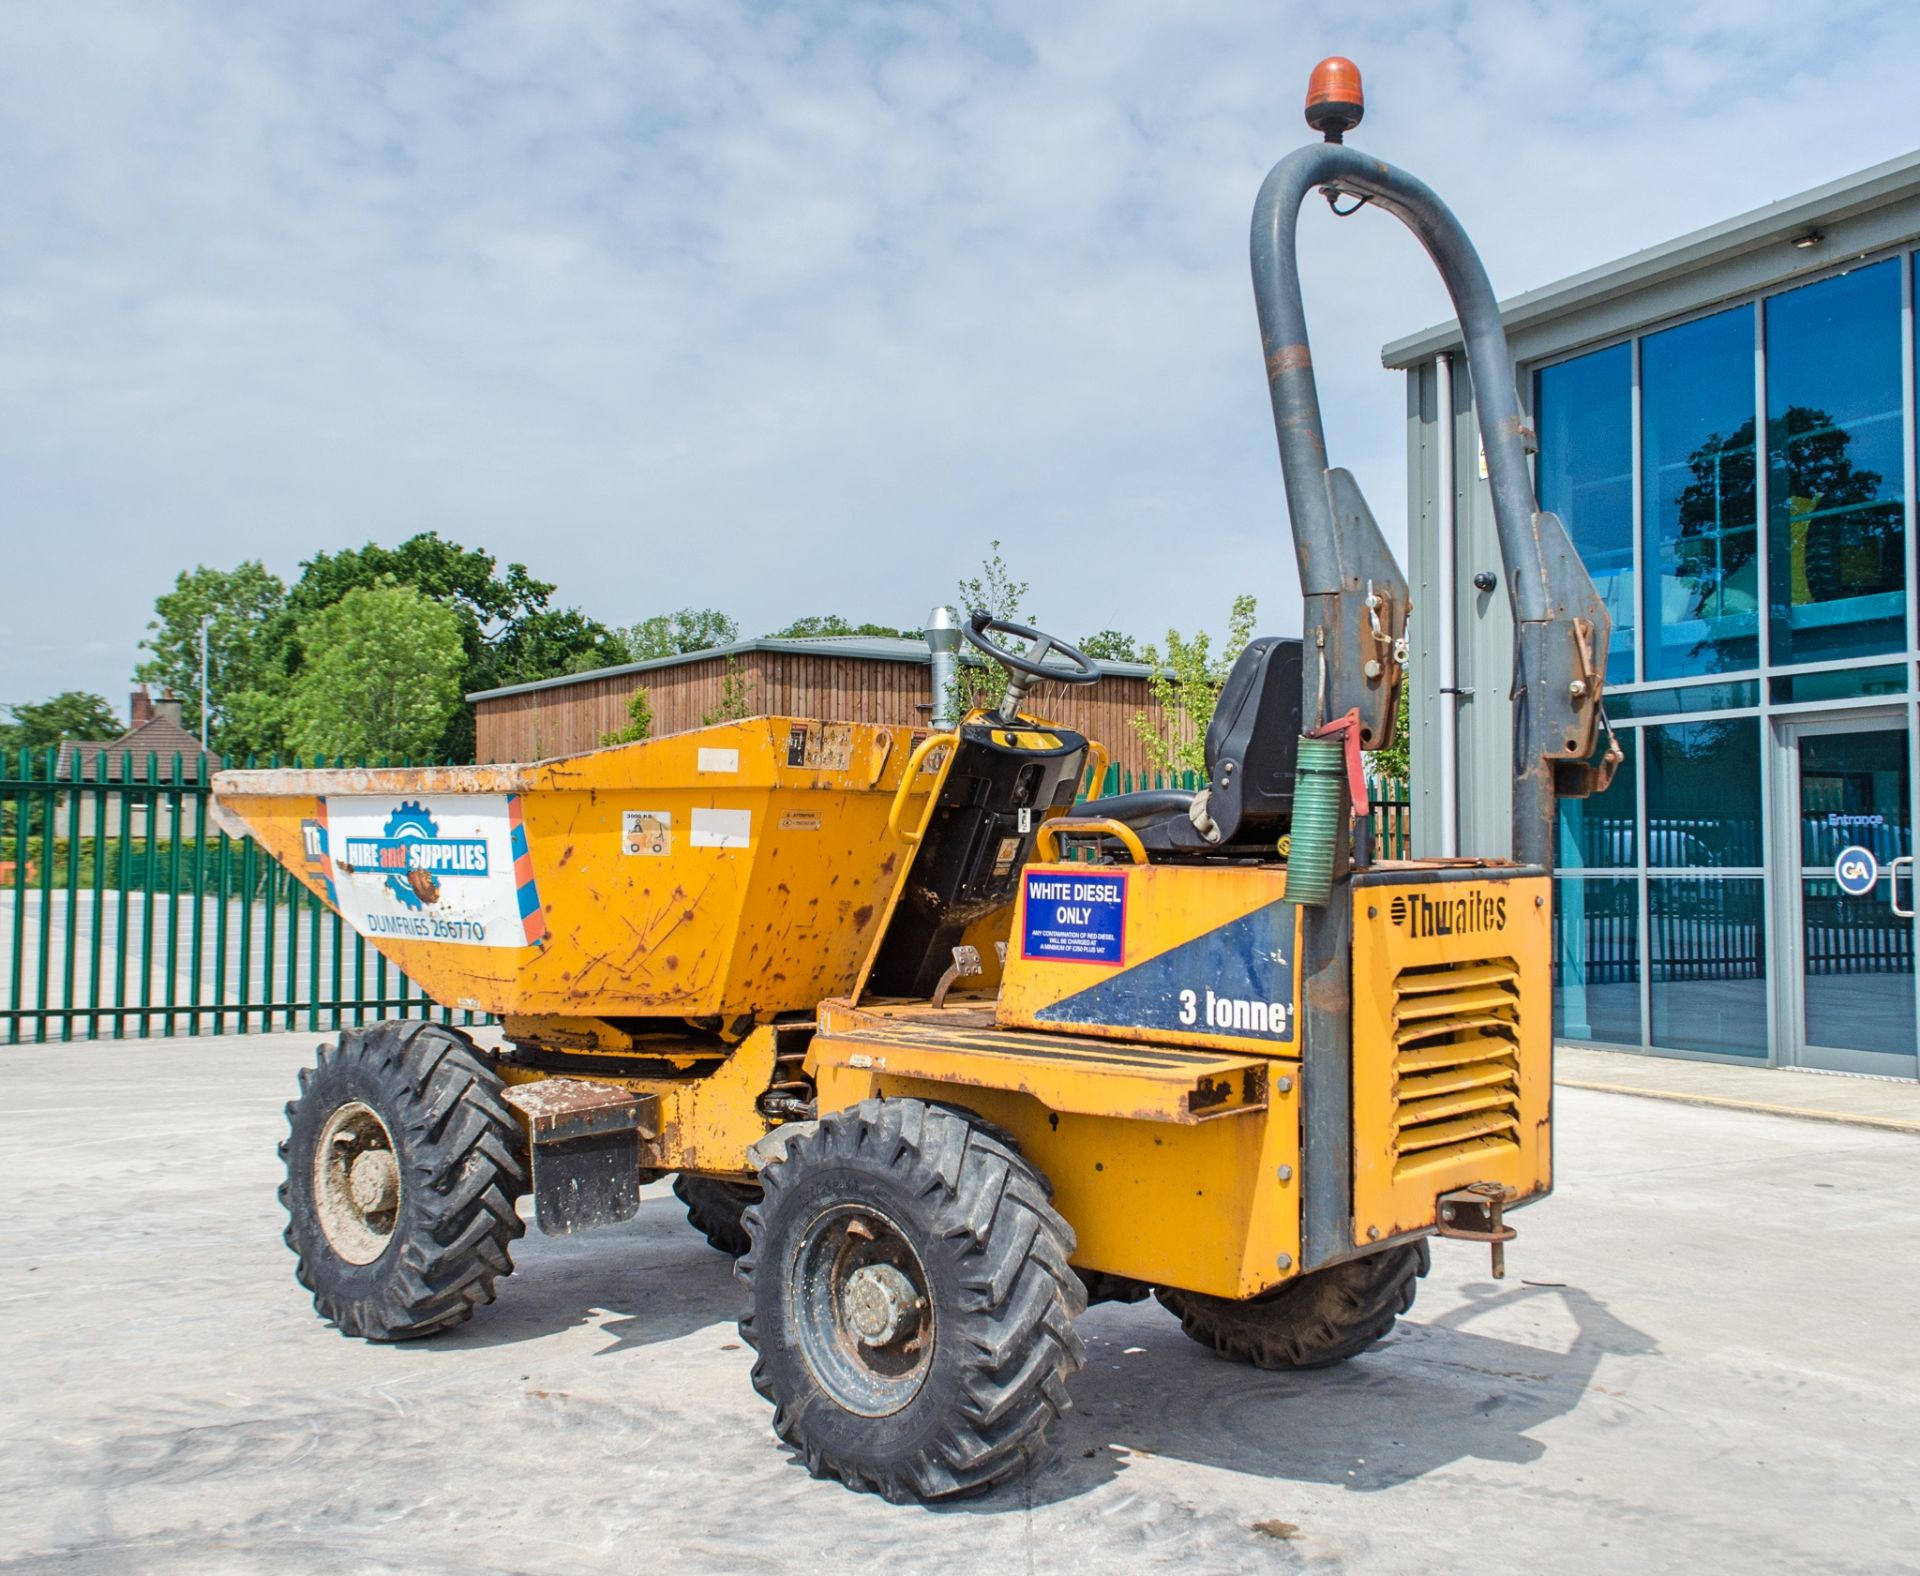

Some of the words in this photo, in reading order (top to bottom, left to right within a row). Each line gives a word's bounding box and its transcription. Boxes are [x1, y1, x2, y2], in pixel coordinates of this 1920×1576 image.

[1828, 813, 1883, 825] Entrance
[348, 842, 379, 867] HIRE
[381, 845, 406, 868] and
[409, 844, 486, 871] SUPPLIES
[1029, 882, 1071, 901] WHITE
[1074, 884, 1121, 903] DIESEL
[1056, 906, 1092, 925] ONLY
[1408, 889, 1506, 938] Thwaites
[368, 914, 429, 936] DUMFRIES
[430, 919, 485, 941] 266770
[1043, 930, 1079, 939] CONTAMINATION
[1179, 989, 1197, 1025] 3
[1206, 990, 1286, 1033] tonne
